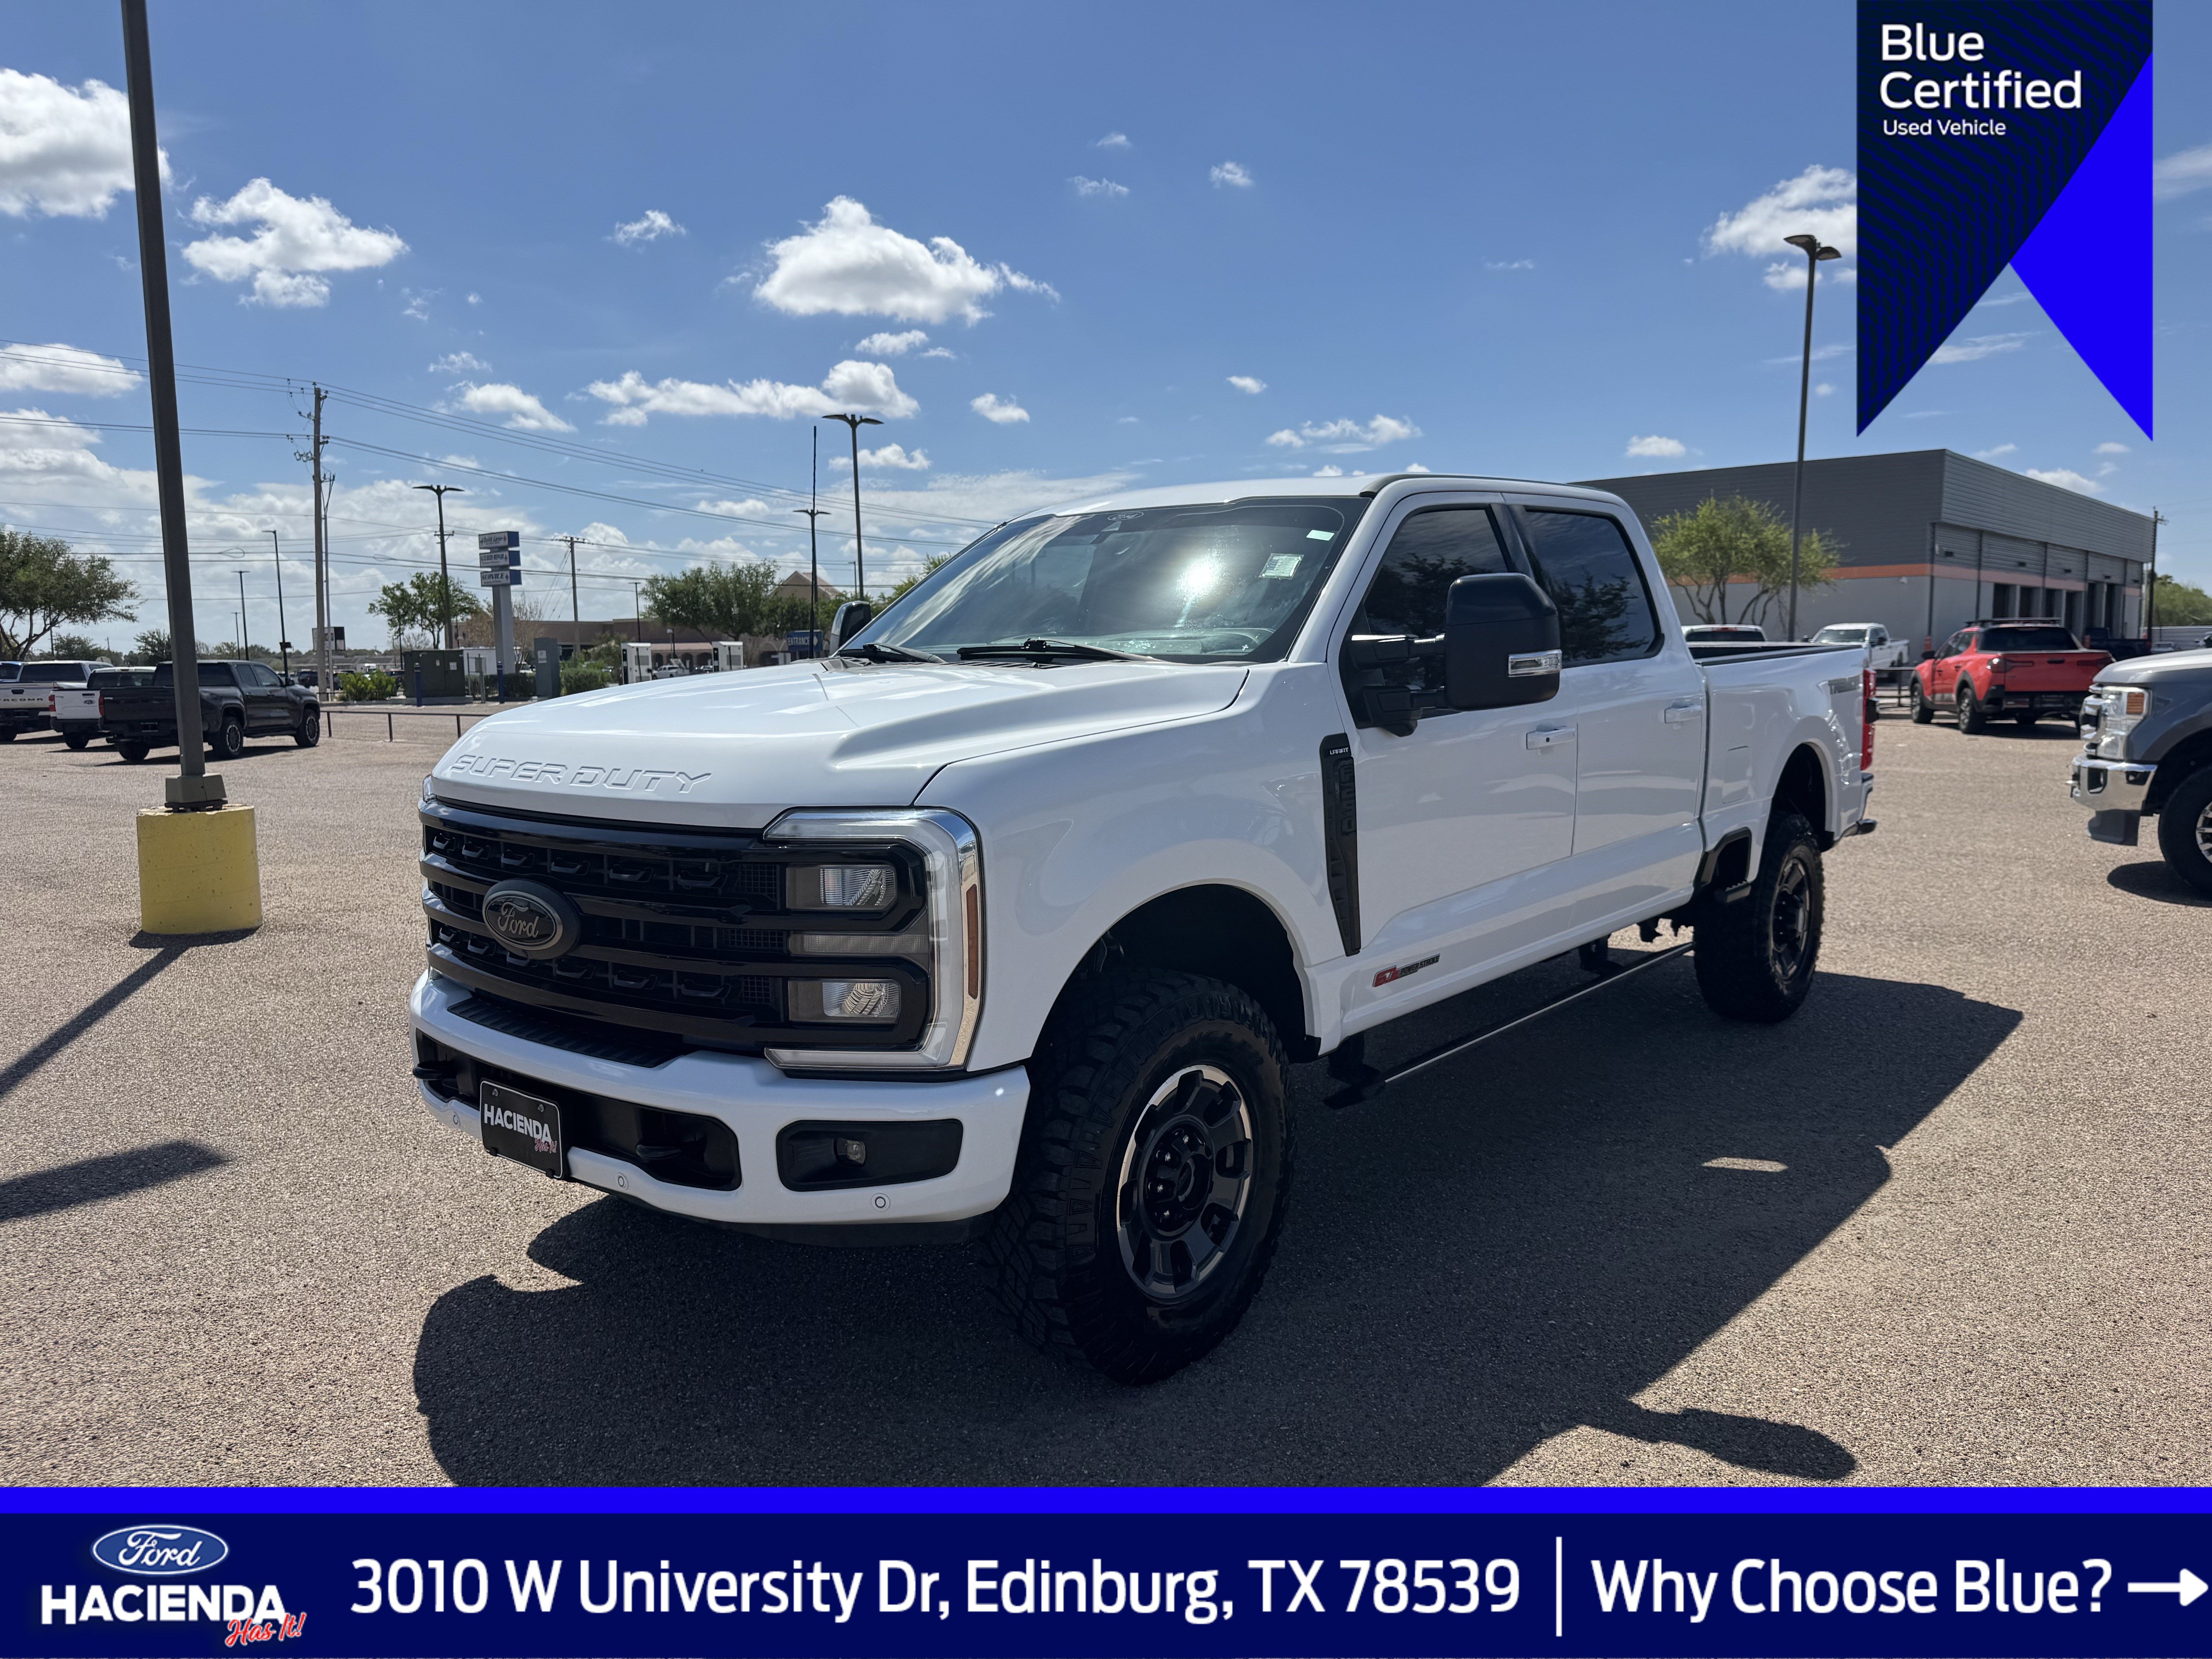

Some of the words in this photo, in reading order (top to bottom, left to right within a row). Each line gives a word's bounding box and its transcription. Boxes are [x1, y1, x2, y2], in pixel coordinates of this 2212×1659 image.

[450, 754, 568, 785] SUPER
[569, 766, 712, 793] DUTY
[498, 902, 539, 938] Ford
[484, 1103, 552, 1145] HACIENDA
